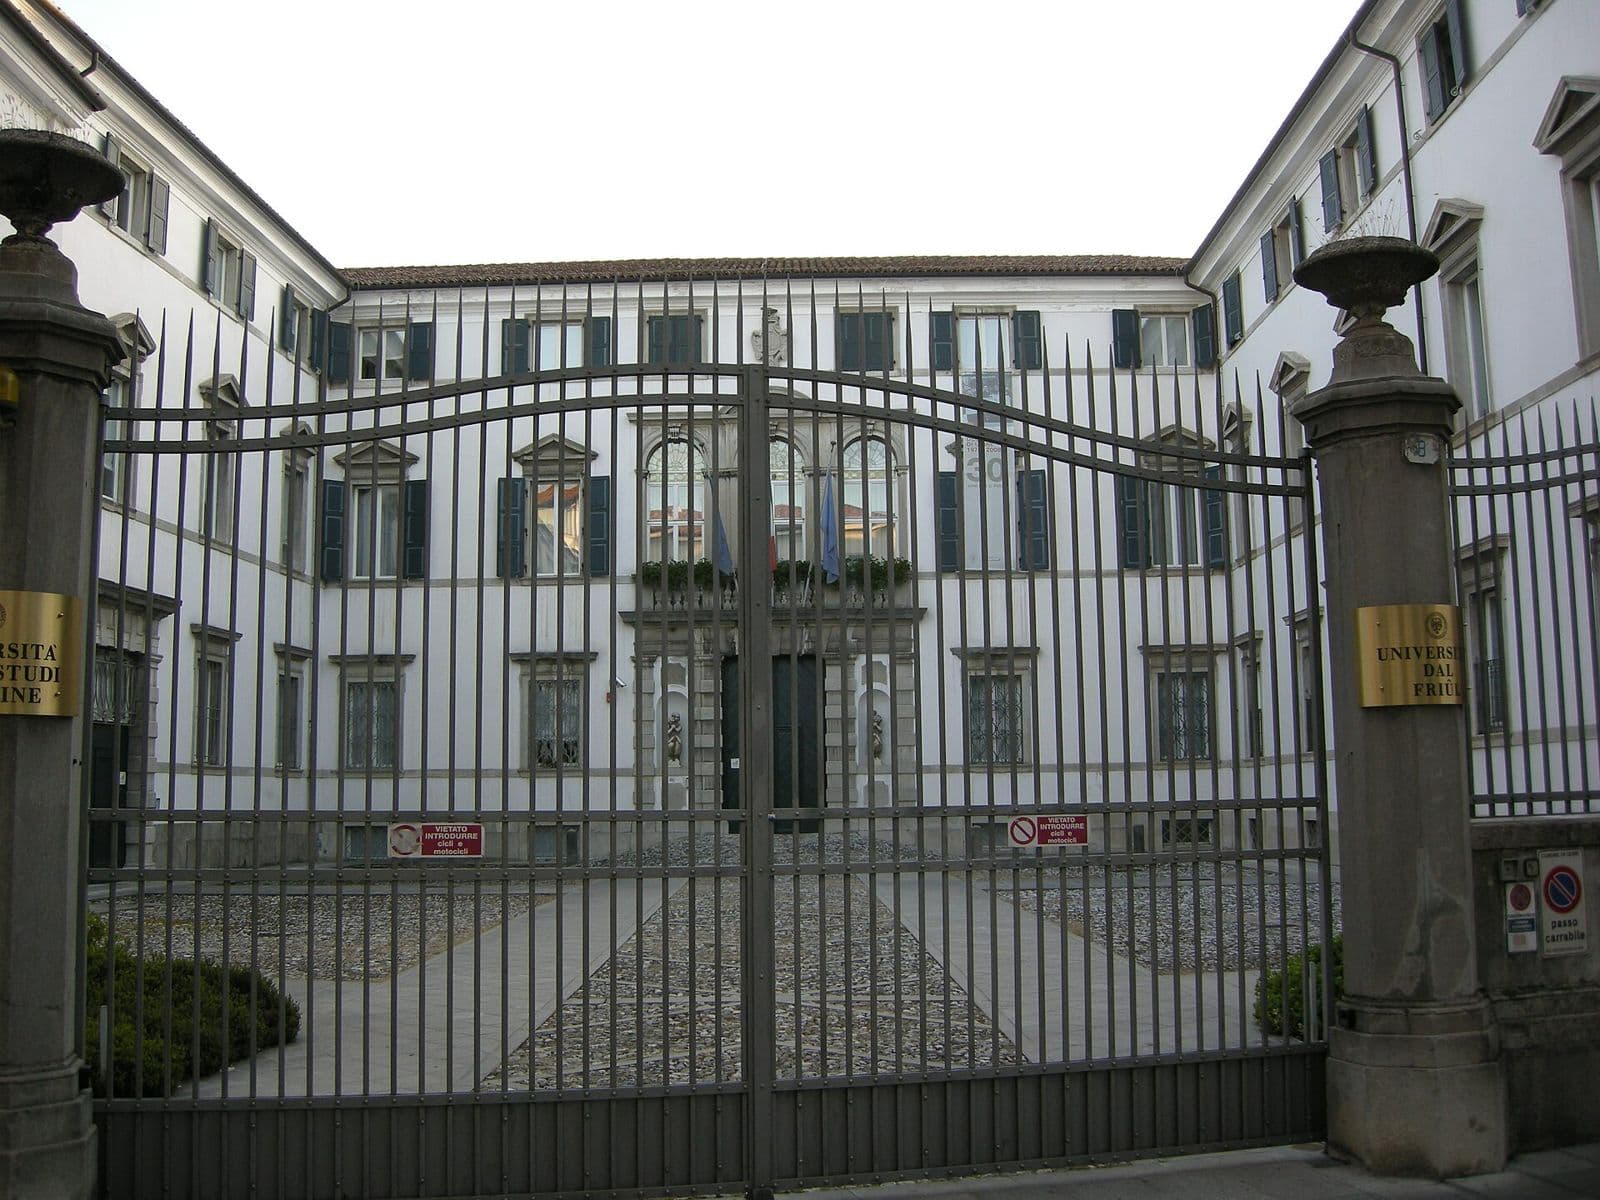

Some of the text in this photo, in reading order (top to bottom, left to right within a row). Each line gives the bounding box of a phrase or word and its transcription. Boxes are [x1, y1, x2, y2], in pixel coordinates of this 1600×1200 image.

[1424, 663, 1454, 677] DAL
[1551, 919, 1578, 930] passo
[1545, 931, 1586, 943] carrabile
